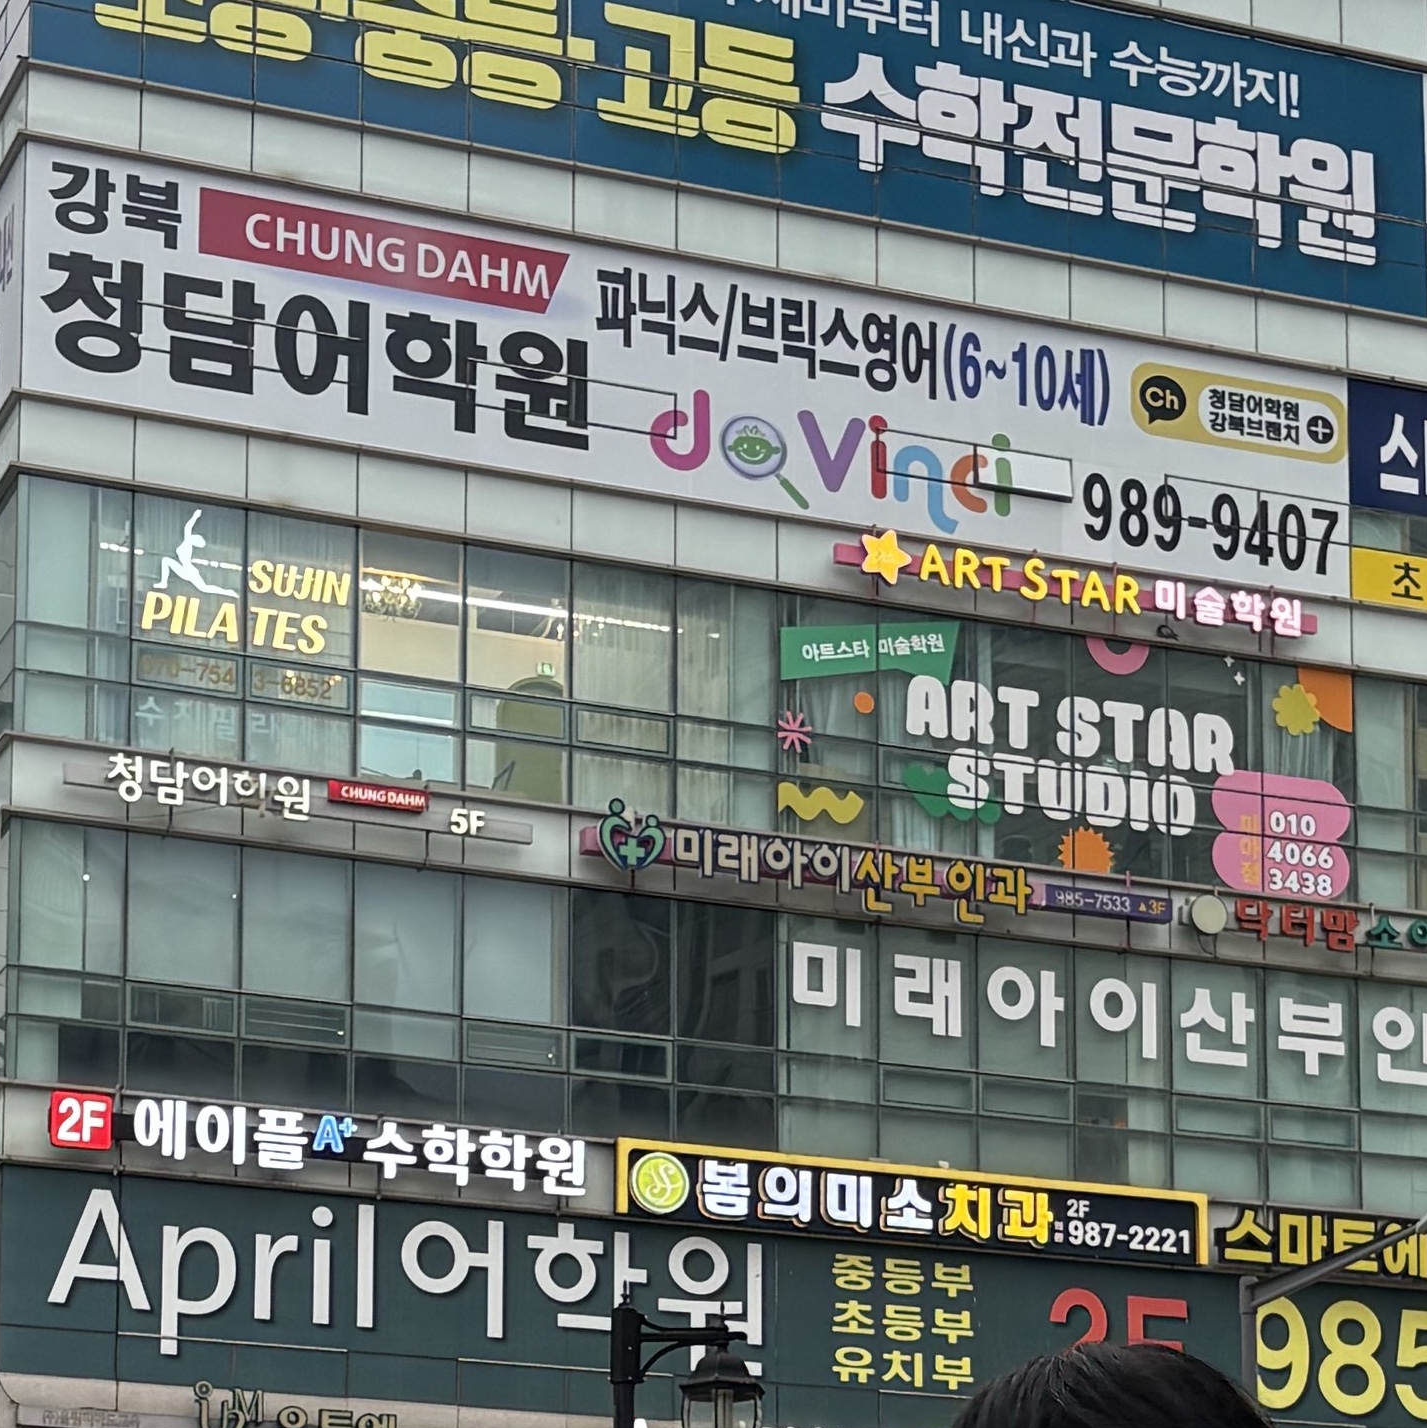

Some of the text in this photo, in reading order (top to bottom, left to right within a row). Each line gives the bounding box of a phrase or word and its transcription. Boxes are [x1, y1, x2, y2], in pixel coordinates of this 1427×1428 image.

[961, 17, 1098, 79] 내신과
[1110, 38, 1302, 119] 수능까지!
[820, 53, 1376, 267] 수학전문학원
[47, 160, 184, 252] 강북
[40, 250, 592, 453] 청담어학원
[1208, 387, 1300, 423] 청담어학원
[1082, 472, 1342, 577] 989-9407
[247, 559, 352, 608] SUJIN
[918, 543, 1305, 640] ART STAR 미술학원
[139, 590, 329, 657] PILATES
[801, 631, 947, 663] 아트스타 미술학원
[906, 674, 1235, 776] ART STAR
[946, 747, 1197, 837] STUDIO
[449, 808, 487, 836] 5F
[1270, 810, 1318, 837] 010
[673, 826, 1035, 926] 미래아이산부인과
[1053, 890, 1131, 915] 985-7533
[1266, 840, 1335, 870] 4066
[1268, 867, 1333, 897] 3438
[1234, 898, 1361, 954] 닥터맘
[57, 1097, 109, 1145] 2F
[701, 1158, 1192, 1255] 봄의미소치과 987-2221
[1065, 1198, 1090, 1219] 2F
[831, 1252, 975, 1298] 중등부
[831, 1299, 975, 1344] 초등부
[831, 1345, 975, 1391] 유치부
